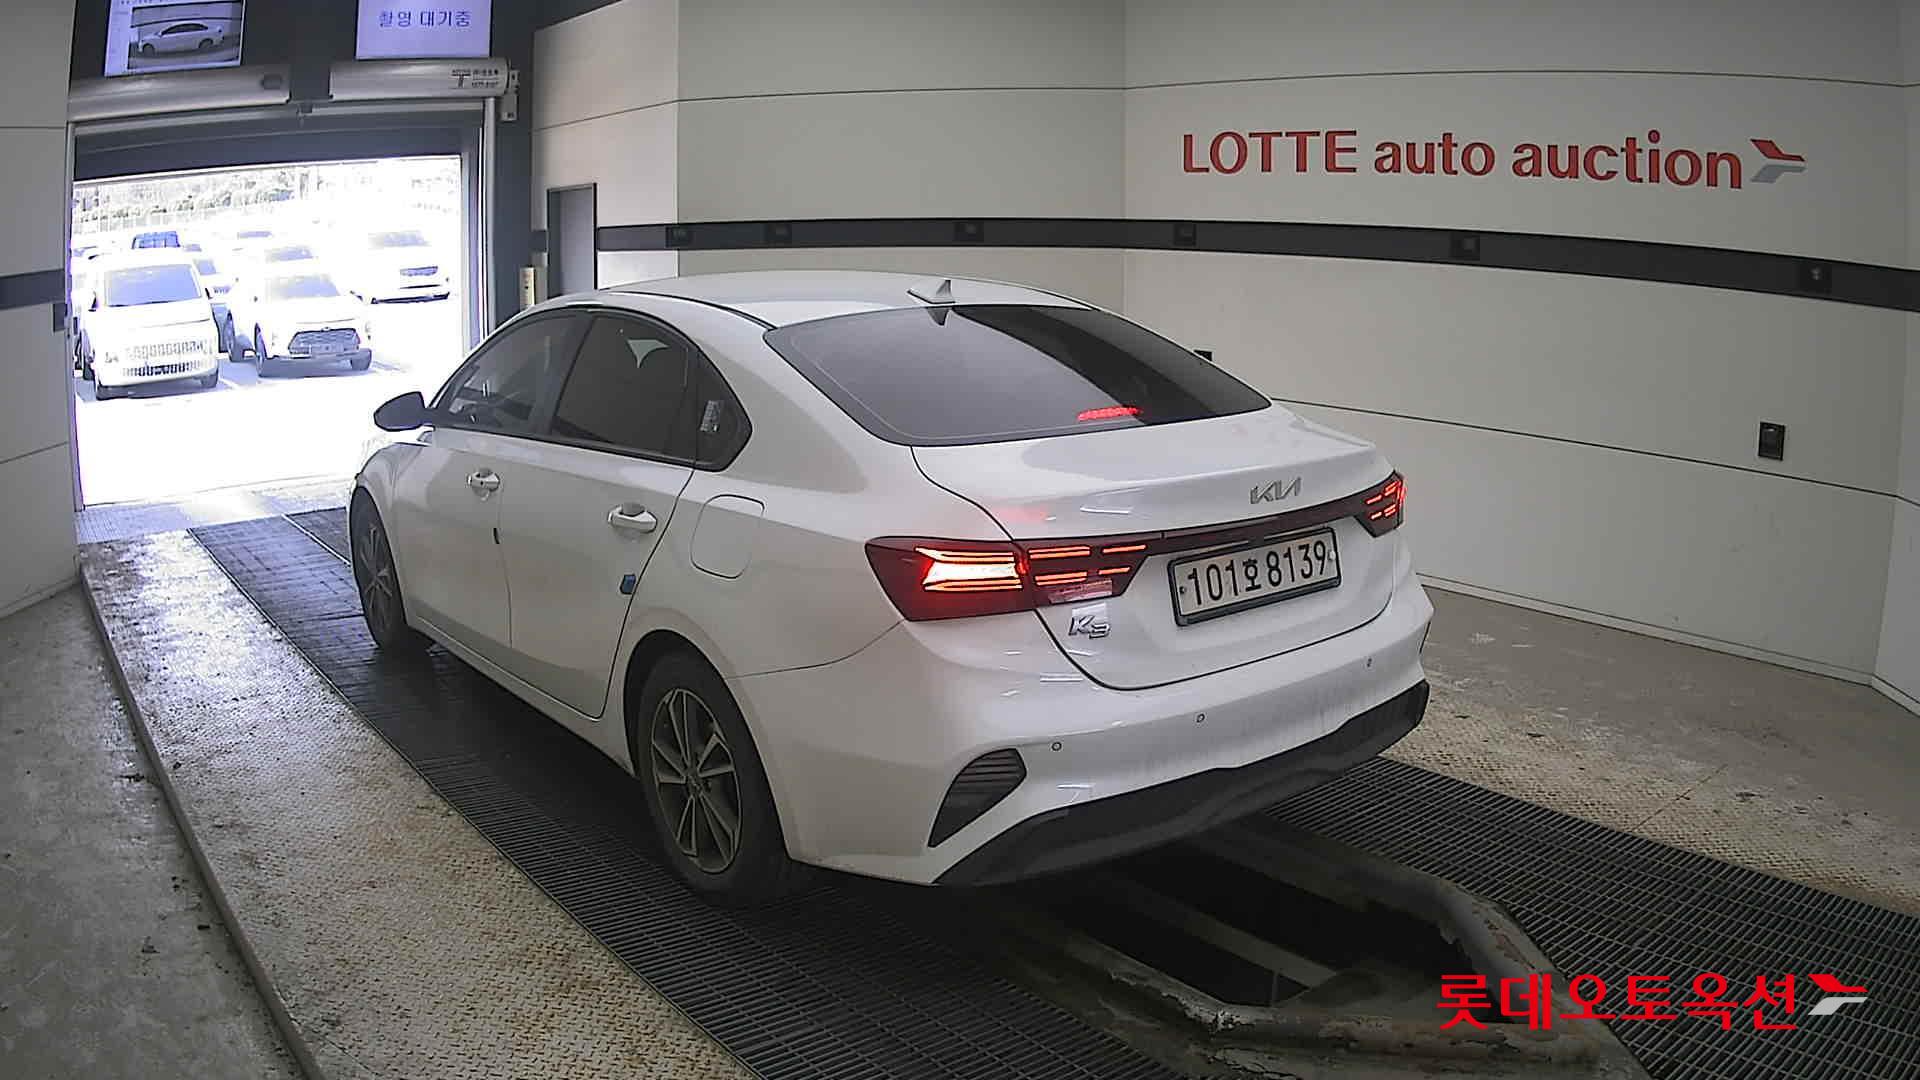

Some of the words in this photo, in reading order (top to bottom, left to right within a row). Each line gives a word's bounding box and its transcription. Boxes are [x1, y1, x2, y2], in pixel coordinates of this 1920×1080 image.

[420, 10, 472, 28] 대기중
[1183, 130, 1358, 174] LOTTE
[1374, 132, 1496, 177] auto
[1512, 129, 1743, 189] auction
[1187, 540, 1327, 606] 101호8139
[1068, 615, 1112, 640] K3
